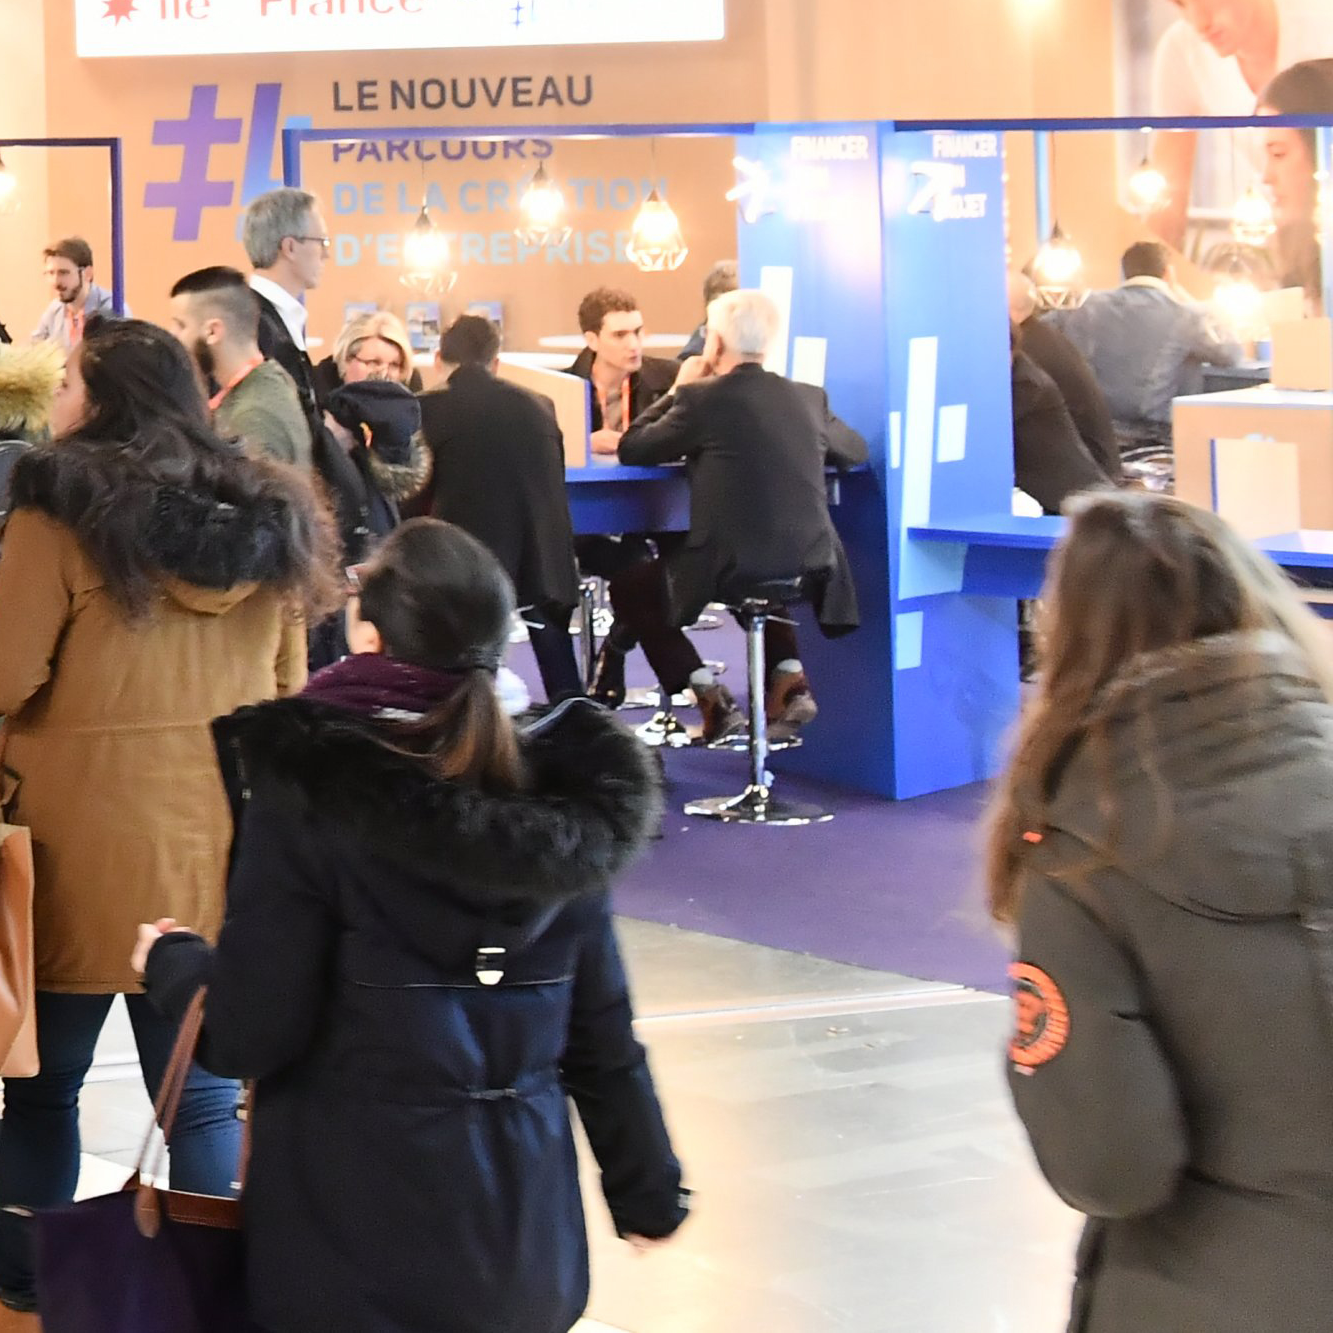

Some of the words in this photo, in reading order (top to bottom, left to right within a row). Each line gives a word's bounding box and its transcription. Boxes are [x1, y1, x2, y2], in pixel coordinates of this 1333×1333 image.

[332, 79, 379, 112] LE
[390, 74, 594, 110] NOUVEAU
[333, 181, 385, 216] DE
[397, 179, 450, 214] LA
